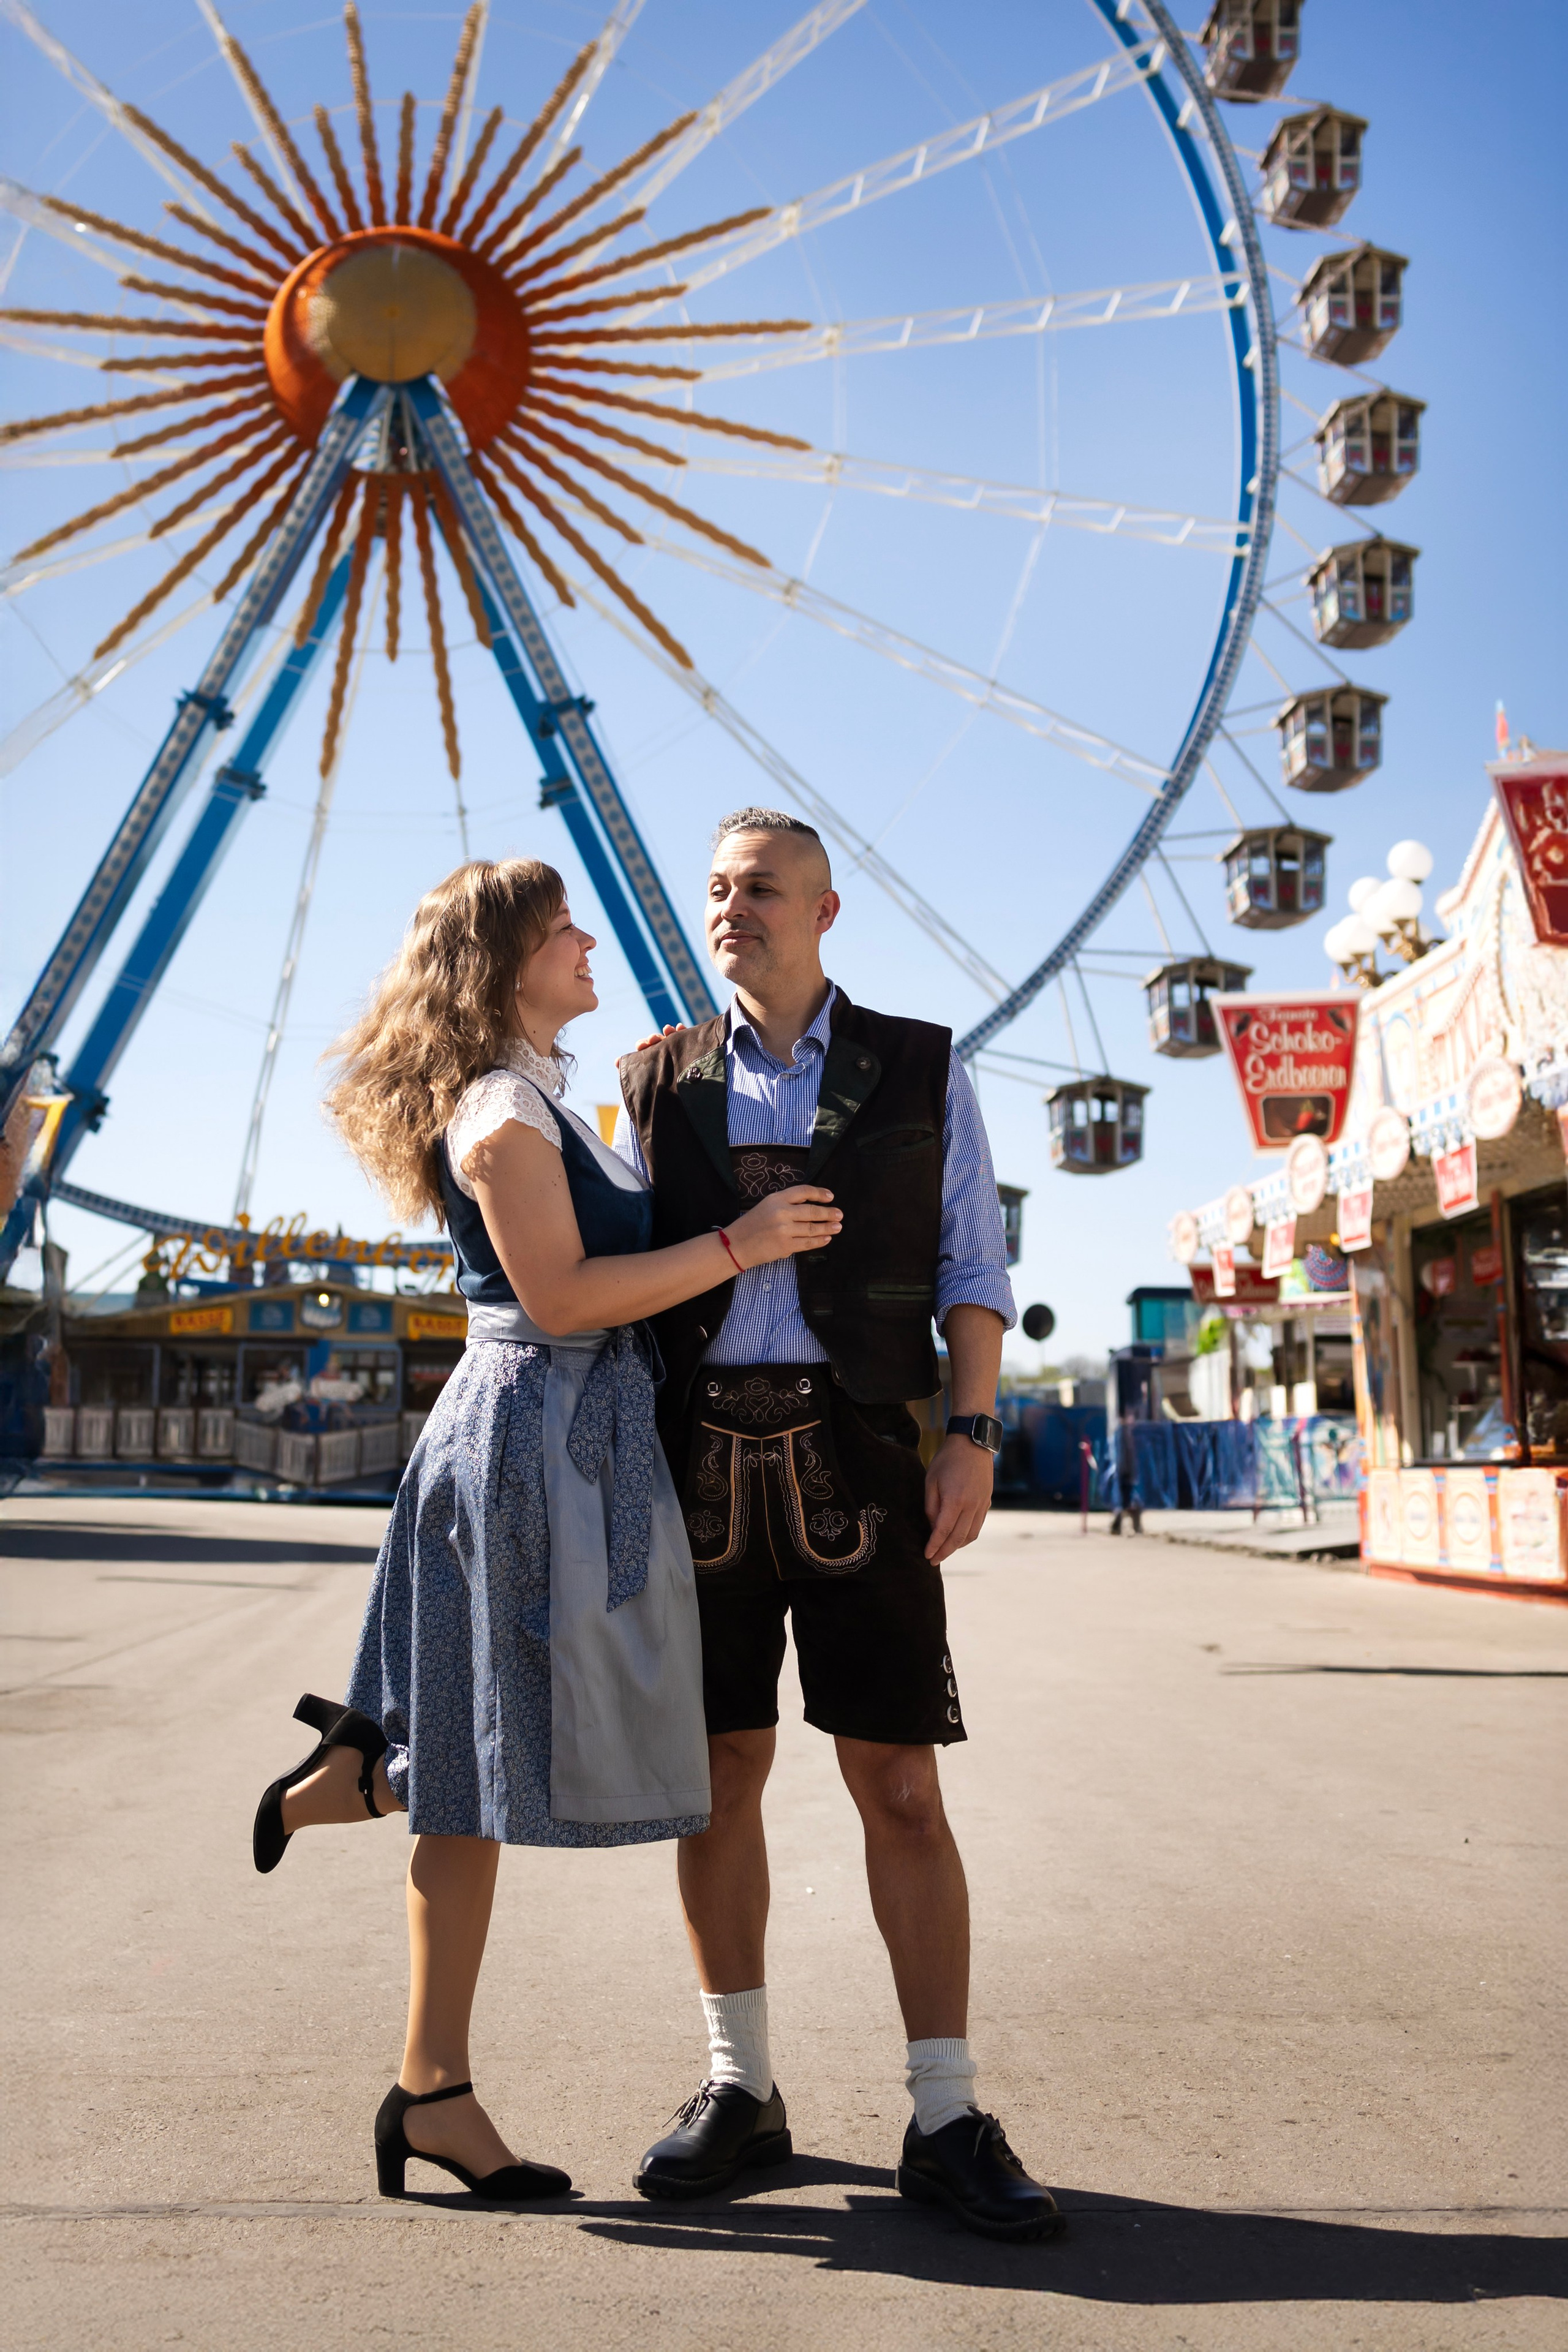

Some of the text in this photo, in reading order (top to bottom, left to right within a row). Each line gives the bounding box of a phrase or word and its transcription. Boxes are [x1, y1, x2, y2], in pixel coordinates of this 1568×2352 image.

[1249, 1020, 1343, 1056] Schoko-
[1244, 1052, 1347, 1095] Erdbeeren
[142, 1212, 458, 1294] Willenbor
